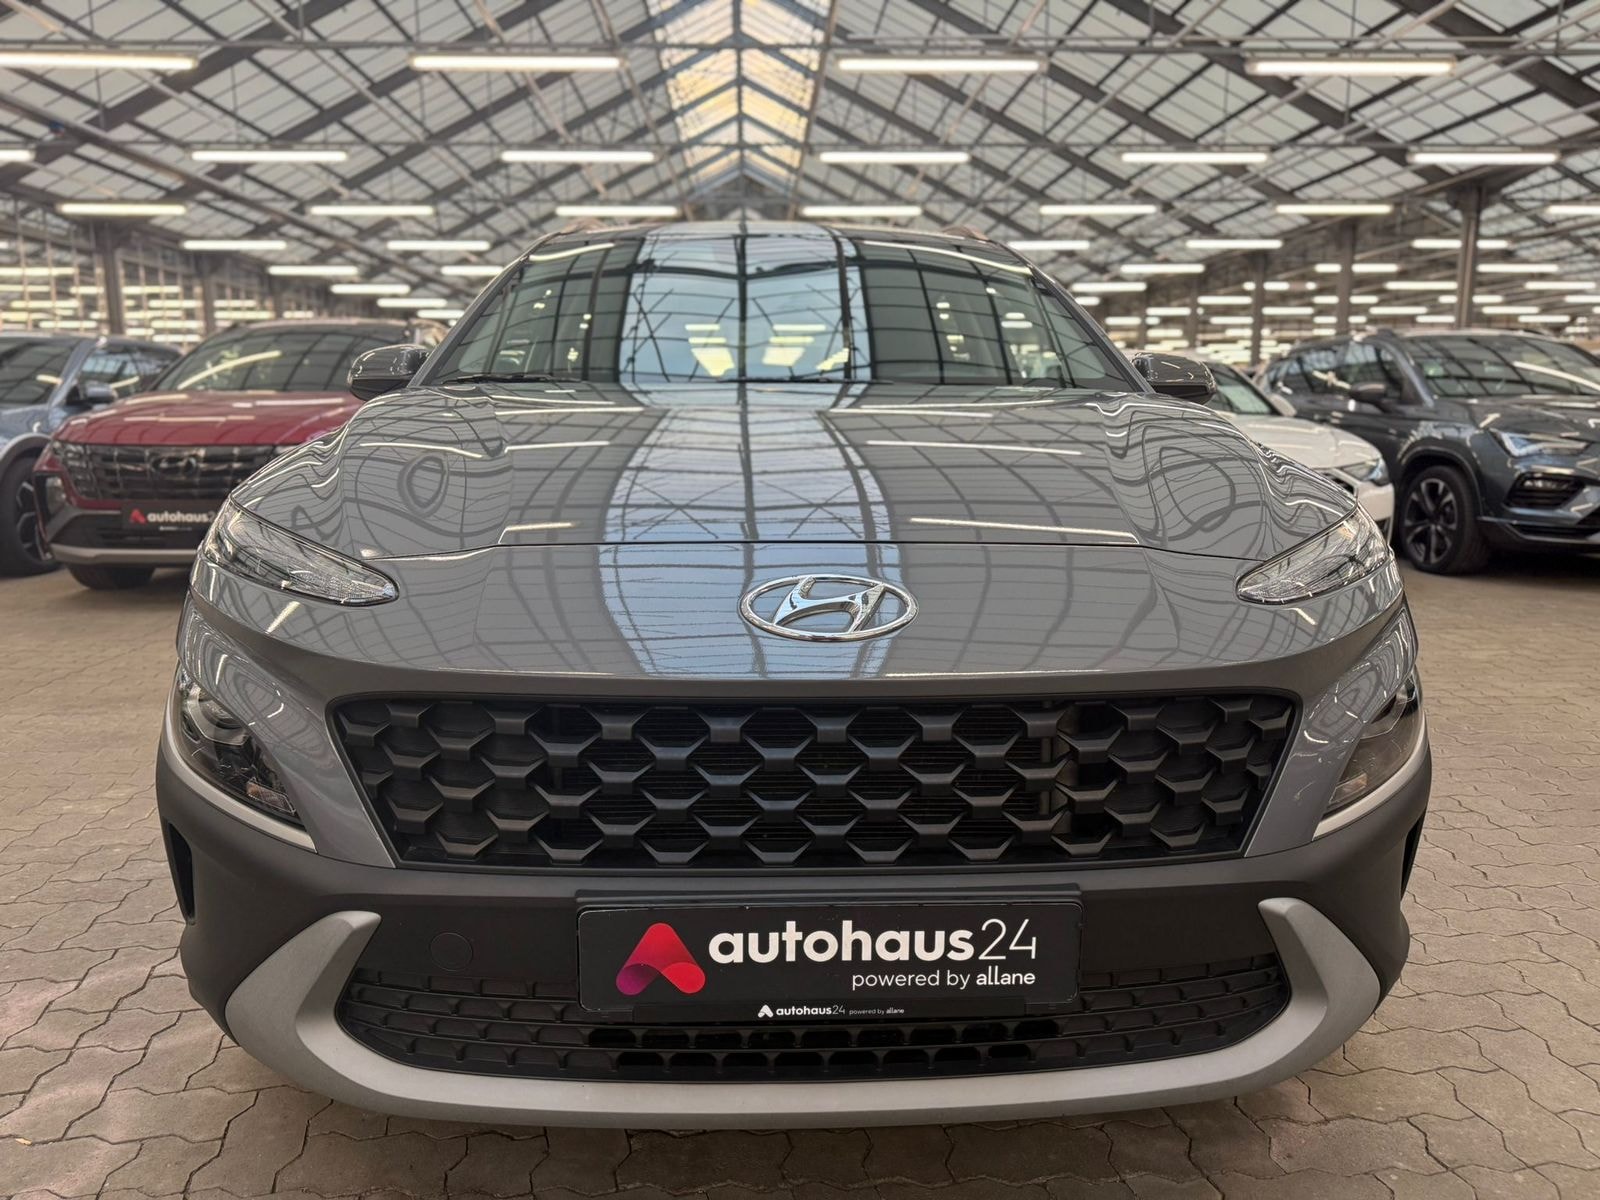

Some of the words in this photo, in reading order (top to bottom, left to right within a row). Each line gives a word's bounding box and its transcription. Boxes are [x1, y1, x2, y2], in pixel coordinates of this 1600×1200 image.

[147, 510, 217, 523] autohaus2
[708, 918, 1037, 963] autohaus24
[852, 969, 940, 991] powered
[946, 968, 971, 990] by
[976, 964, 1036, 986] allane
[776, 1004, 846, 1016] autohaus24
[849, 1008, 877, 1016] powered
